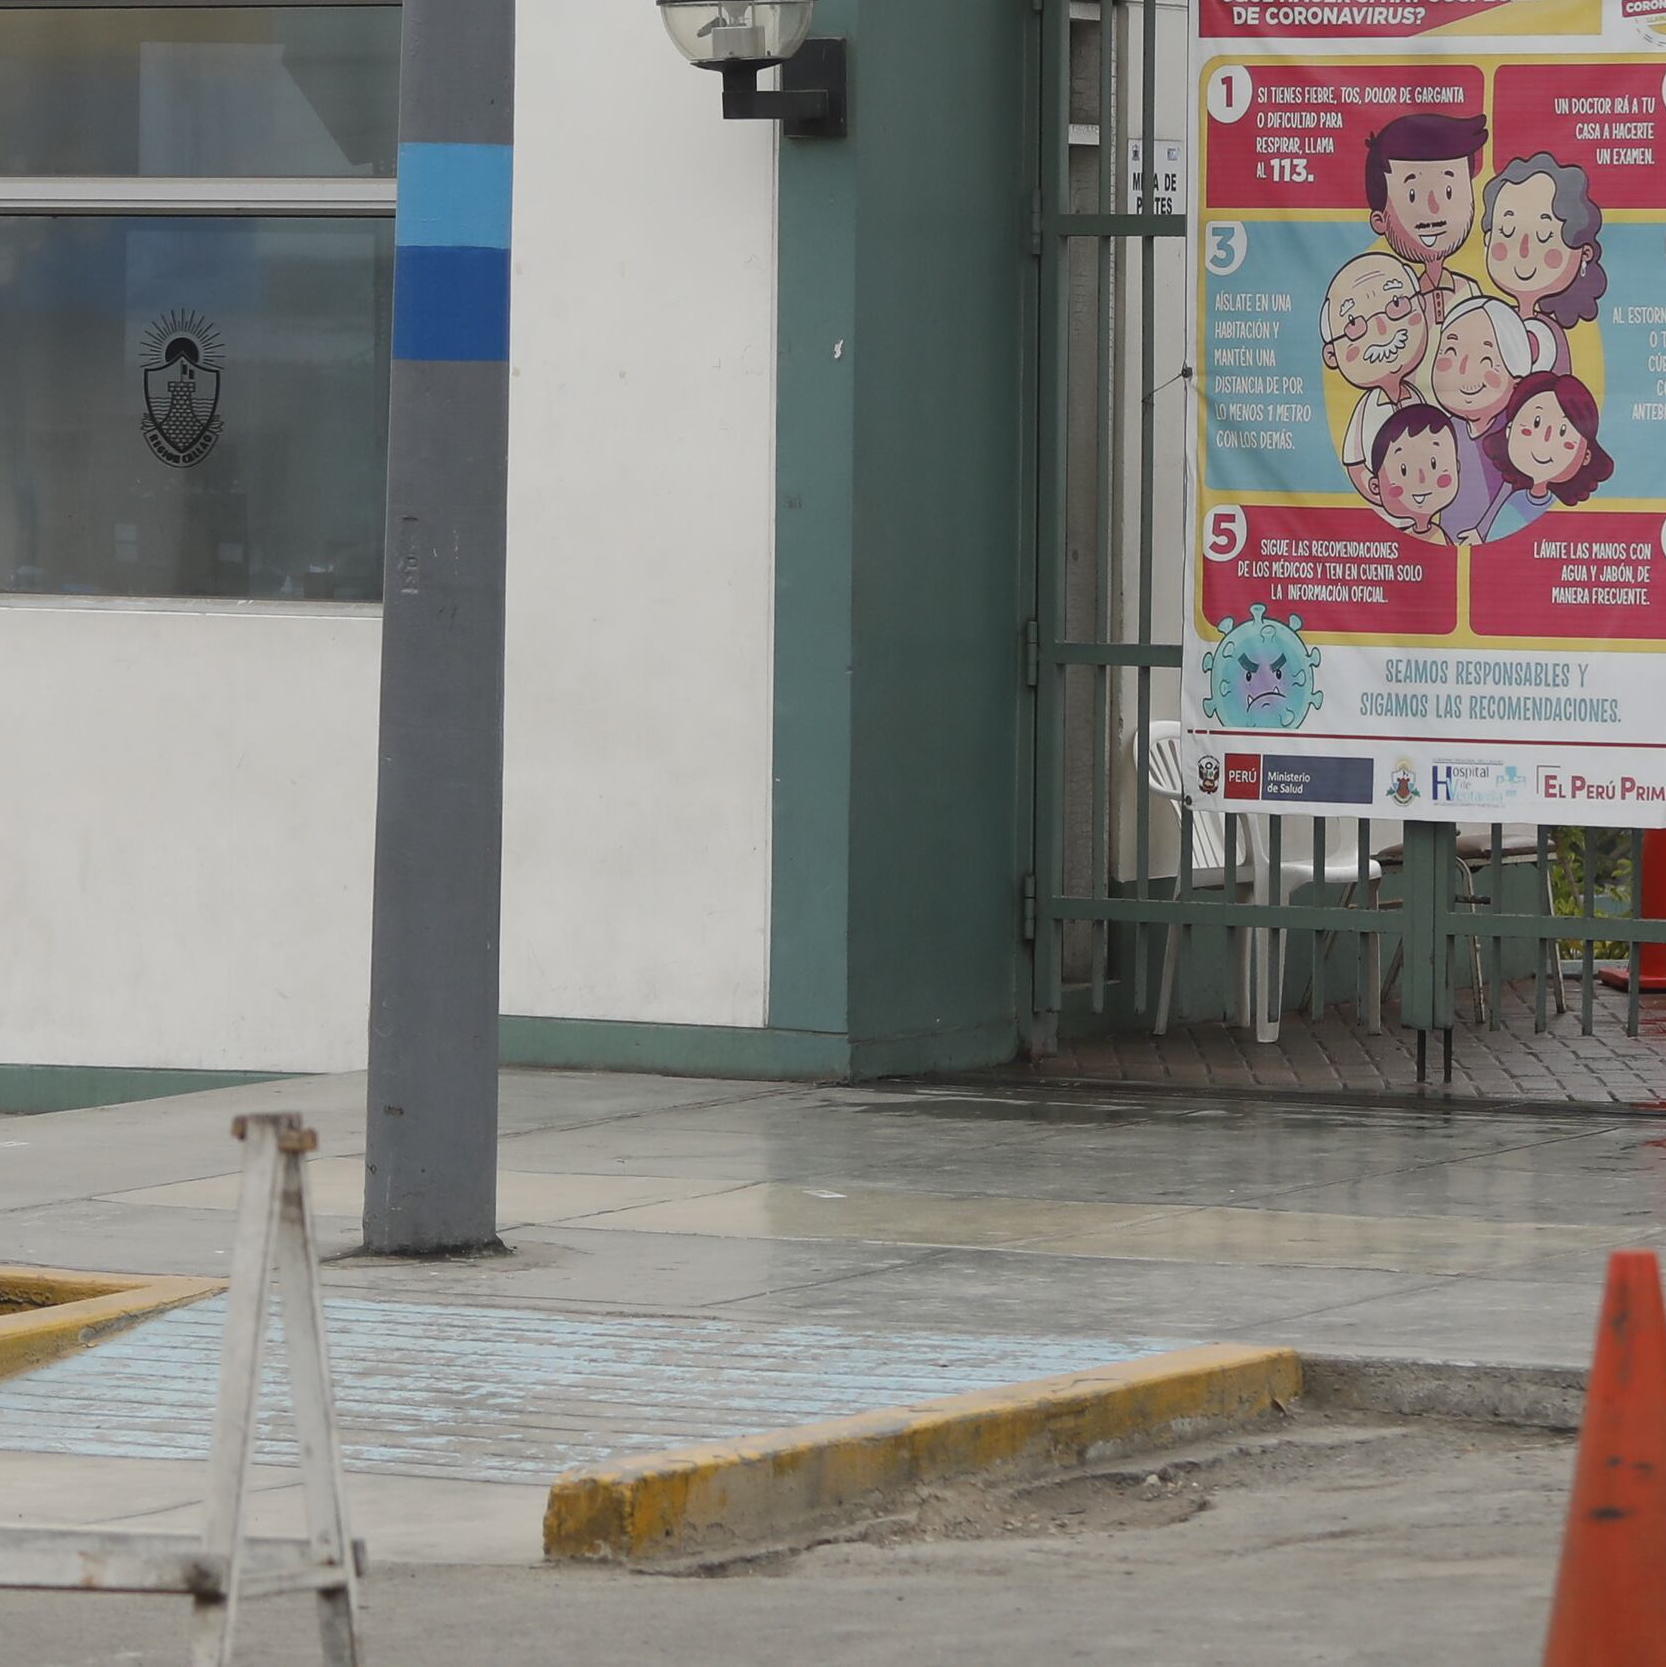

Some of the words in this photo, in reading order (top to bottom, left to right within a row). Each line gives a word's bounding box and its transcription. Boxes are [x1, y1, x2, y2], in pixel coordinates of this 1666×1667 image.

[1233, 6, 1259, 25] DE
[1265, 6, 1425, 25] CORONAVIRUS?
[1221, 76, 1233, 108] 1
[1258, 87, 1267, 104] SI
[1270, 87, 1302, 104] TIENES
[1305, 87, 1337, 105] FIEBRE,
[1341, 87, 1361, 105] TOS,
[1365, 87, 1397, 104] DOLOR
[1400, 87, 1411, 104] DE
[1415, 87, 1464, 104] GARGANTA
[1555, 98, 1568, 114] UN
[1572, 98, 1611, 114] DOCTOR
[1614, 95, 1630, 114] IRÁ
[1631, 98, 1638, 114] A
[1642, 97, 1655, 114] TU
[1257, 112, 1264, 128] O
[1268, 112, 1316, 128] DIFICULTAD
[1320, 112, 1343, 128] PARA
[1576, 123, 1601, 139] CASA
[1603, 123, 1610, 139] A
[1612, 123, 1654, 139] HACERTE
[1256, 137, 1302, 155] RESPIRAR,
[1305, 137, 1334, 154] LLAMA
[1597, 149, 1610, 165] UN
[1613, 148, 1655, 165] EXAMEN.
[1256, 162, 1266, 178] AL
[1270, 158, 1315, 182] 113.
[1133, 173, 1158, 191] MA
[1164, 174, 1177, 191] DE
[1137, 197, 1172, 214] PTES
[1209, 227, 1235, 269] 3
[1215, 290, 1252, 312] AÍSLATE
[1256, 294, 1268, 311] EN
[1272, 294, 1291, 311] UNA
[1613, 307, 1625, 324] AL
[1215, 319, 1270, 339] HABITACIÓN
[1273, 322, 1279, 338] Y
[1650, 331, 1658, 348] O
[1214, 346, 1252, 367] MANTÉN
[1256, 349, 1276, 367] UNA
[1215, 376, 1263, 394] DISTANCIA
[1266, 377, 1279, 394] DE
[1283, 377, 1303, 394] POR
[1215, 403, 1226, 421] LO
[1229, 404, 1263, 421] MENOS
[1267, 404, 1273, 421] 1
[1276, 404, 1311, 422] METRO
[149, 434, 181, 464] REGION
[181, 434, 212, 464] CALLAO
[1216, 430, 1237, 448] CON
[1239, 431, 1257, 449] LOS
[1260, 429, 1295, 449] DEMÁS.
[1208, 513, 1236, 555] 5
[1261, 539, 1289, 556] SIGUE
[1292, 541, 1309, 557] LAS
[1312, 541, 1399, 559] RECOMENDACIONES
[1534, 539, 1567, 559] LÁVATE
[1570, 542, 1589, 559] LAS
[1592, 542, 1626, 560] MANOS
[1630, 543, 1651, 560] CON
[1238, 562, 1249, 577] DE
[1253, 562, 1269, 577] LOS
[1272, 559, 1314, 579] MÉDICOS
[1316, 563, 1322, 578] Y
[1325, 563, 1342, 579] TEN
[1345, 564, 1358, 579] EN
[1360, 564, 1395, 581] CUENTA
[1397, 565, 1422, 581] SOLO
[1561, 565, 1588, 581] AGUA
[1590, 565, 1597, 581] Y
[1600, 562, 1635, 584] JABÓN,
[1638, 566, 1650, 583] DE
[1271, 584, 1282, 600] LA
[1288, 582, 1349, 602] INFORMACIÓN
[1351, 585, 1388, 603] OFICIAL.
[1552, 588, 1589, 604] MANERA
[1592, 588, 1650, 605] FRECUENTE.
[1385, 658, 1448, 684] SEAMOS
[1456, 660, 1569, 688] RESPONSABLES
[1577, 662, 1589, 688] Y
[1360, 692, 1428, 718] SIGAMOS
[1435, 693, 1462, 720] LAS
[1469, 694, 1622, 724] RECOMENDACIONES.
[1229, 768, 1257, 783] PERÚ
[1267, 771, 1311, 783] Ministerio
[1432, 766, 1489, 800] Hospital
[1267, 783, 1279, 794] de
[1281, 783, 1303, 794] Salud
[1544, 775, 1566, 799] EL
[1571, 775, 1615, 800] PERÚ
